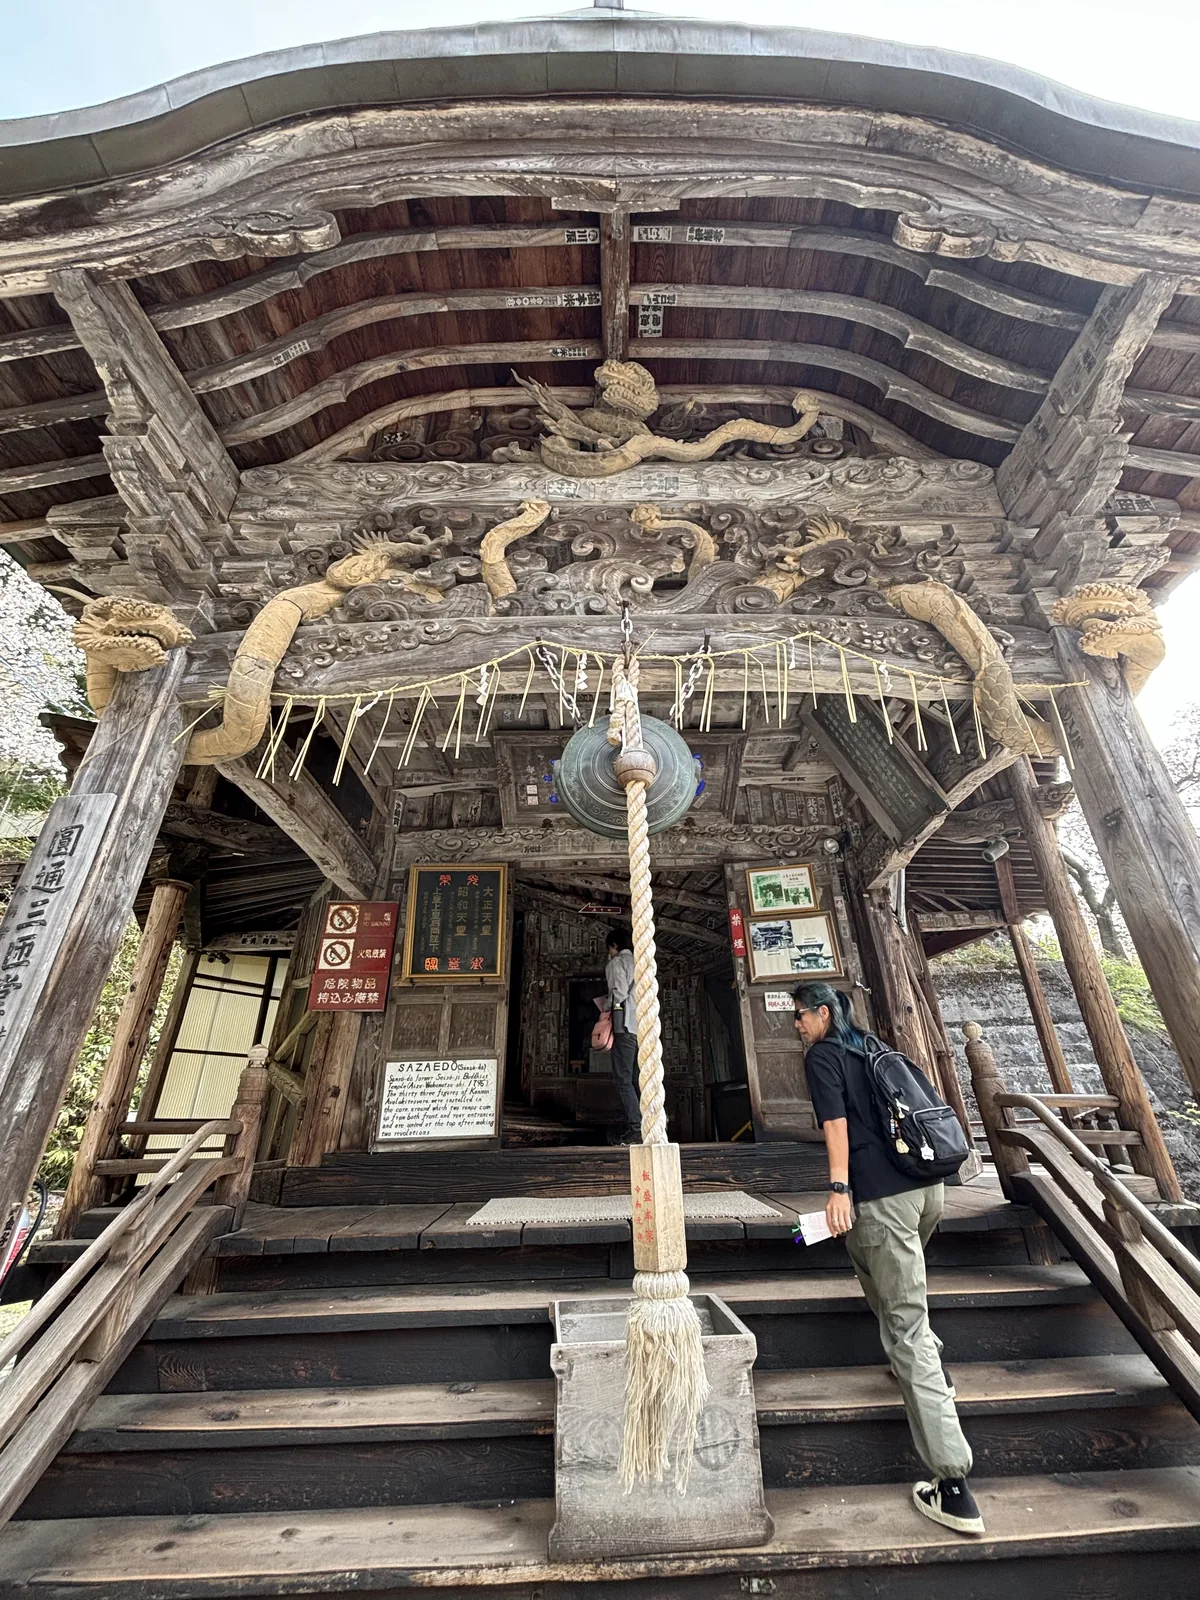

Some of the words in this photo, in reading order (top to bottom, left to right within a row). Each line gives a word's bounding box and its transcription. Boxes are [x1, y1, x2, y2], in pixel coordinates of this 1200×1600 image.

[455, 887, 468, 937] 昭和天皇
[481, 887, 494, 936] 大正天皇
[731, 913, 745, 949] 禁煙
[324, 978, 377, 990] 危険物品
[317, 992, 380, 1004] 持込み厳禁
[387, 1090, 396, 1098] The
[437, 1089, 458, 1097] figures
[461, 1088, 468, 1097] of
[446, 1094, 472, 1103] installed
[432, 1103, 447, 1111] which
[407, 1112, 420, 1120] both
[440, 1111, 451, 1119] and
[382, 1120, 394, 1129] and
[434, 1119, 444, 1127] the
[458, 1118, 474, 1128] after
[476, 1118, 495, 1128] making
